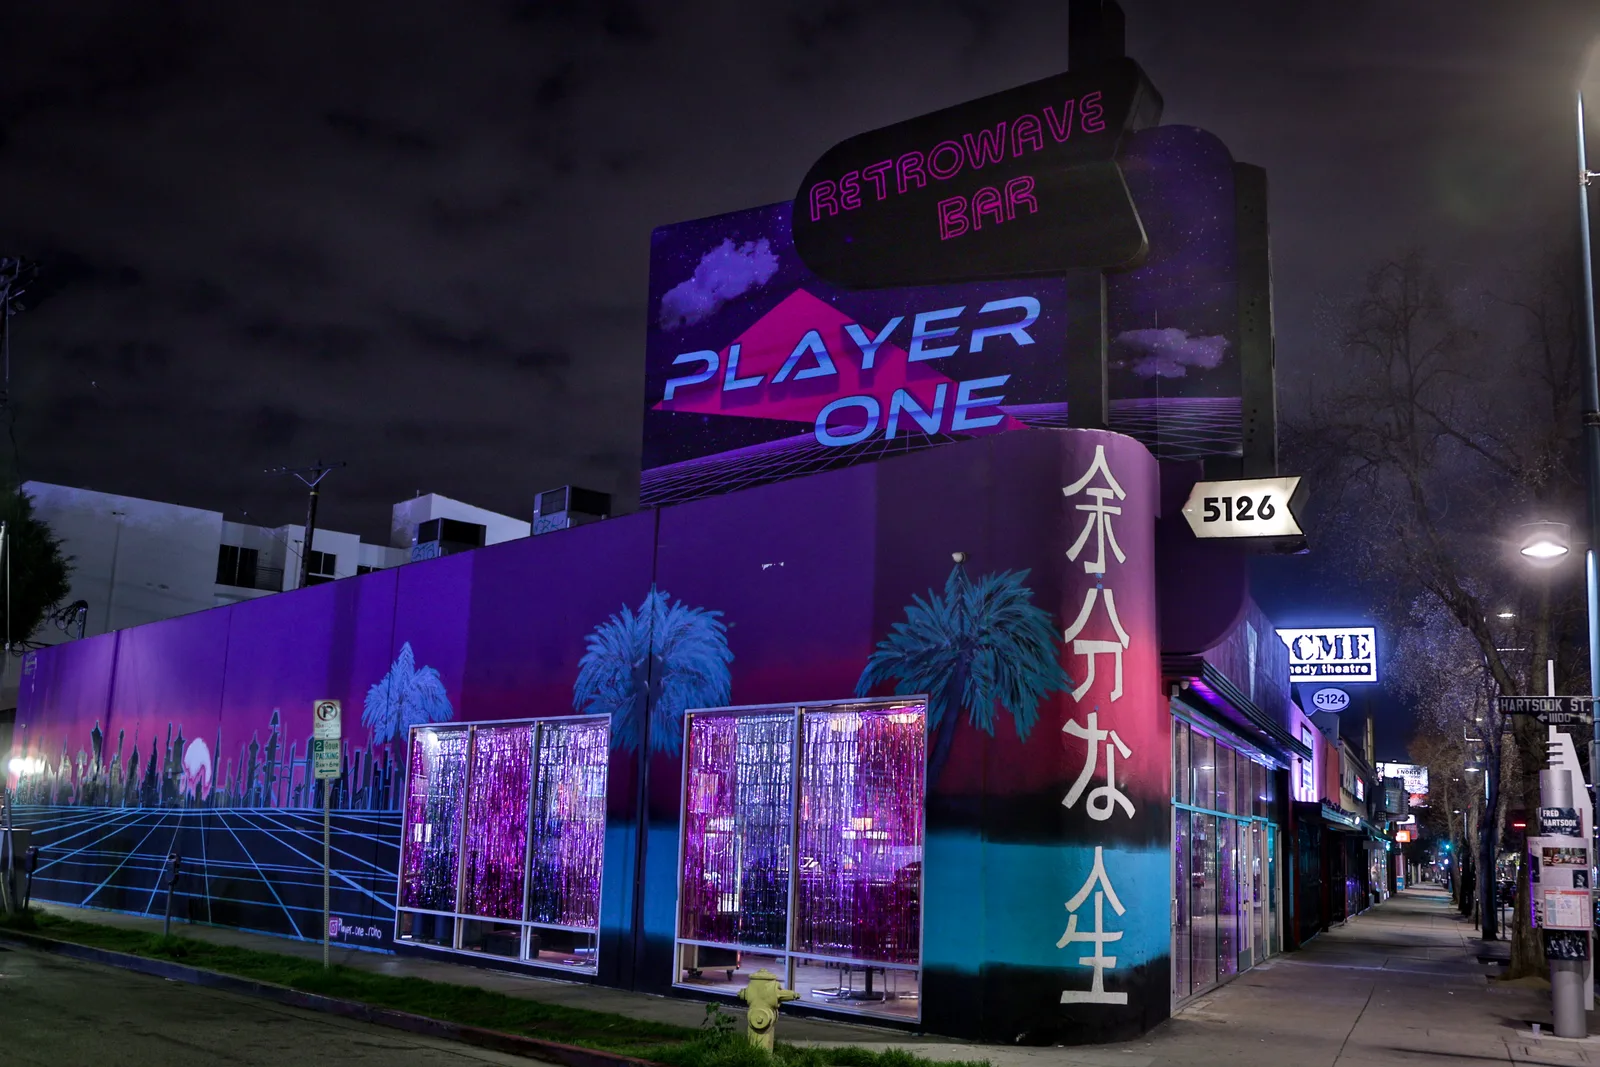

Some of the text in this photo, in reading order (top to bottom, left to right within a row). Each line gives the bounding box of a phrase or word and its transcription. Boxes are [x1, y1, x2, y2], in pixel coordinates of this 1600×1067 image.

[810, 91, 1106, 221] RETROWAVE
[937, 175, 1039, 241] BAR
[663, 295, 1041, 401] PLAYER
[814, 374, 1010, 448] ONE
[1203, 495, 1276, 525] 5126
[1292, 634, 1371, 660] CME
[1290, 664, 1369, 676] edy theatre
[1316, 693, 1346, 704] 5124
[1501, 699, 1590, 712] HARTSOOK ST.
[315, 752, 339, 761] PARKING
[1543, 819, 1577, 827] HARTSOOK
